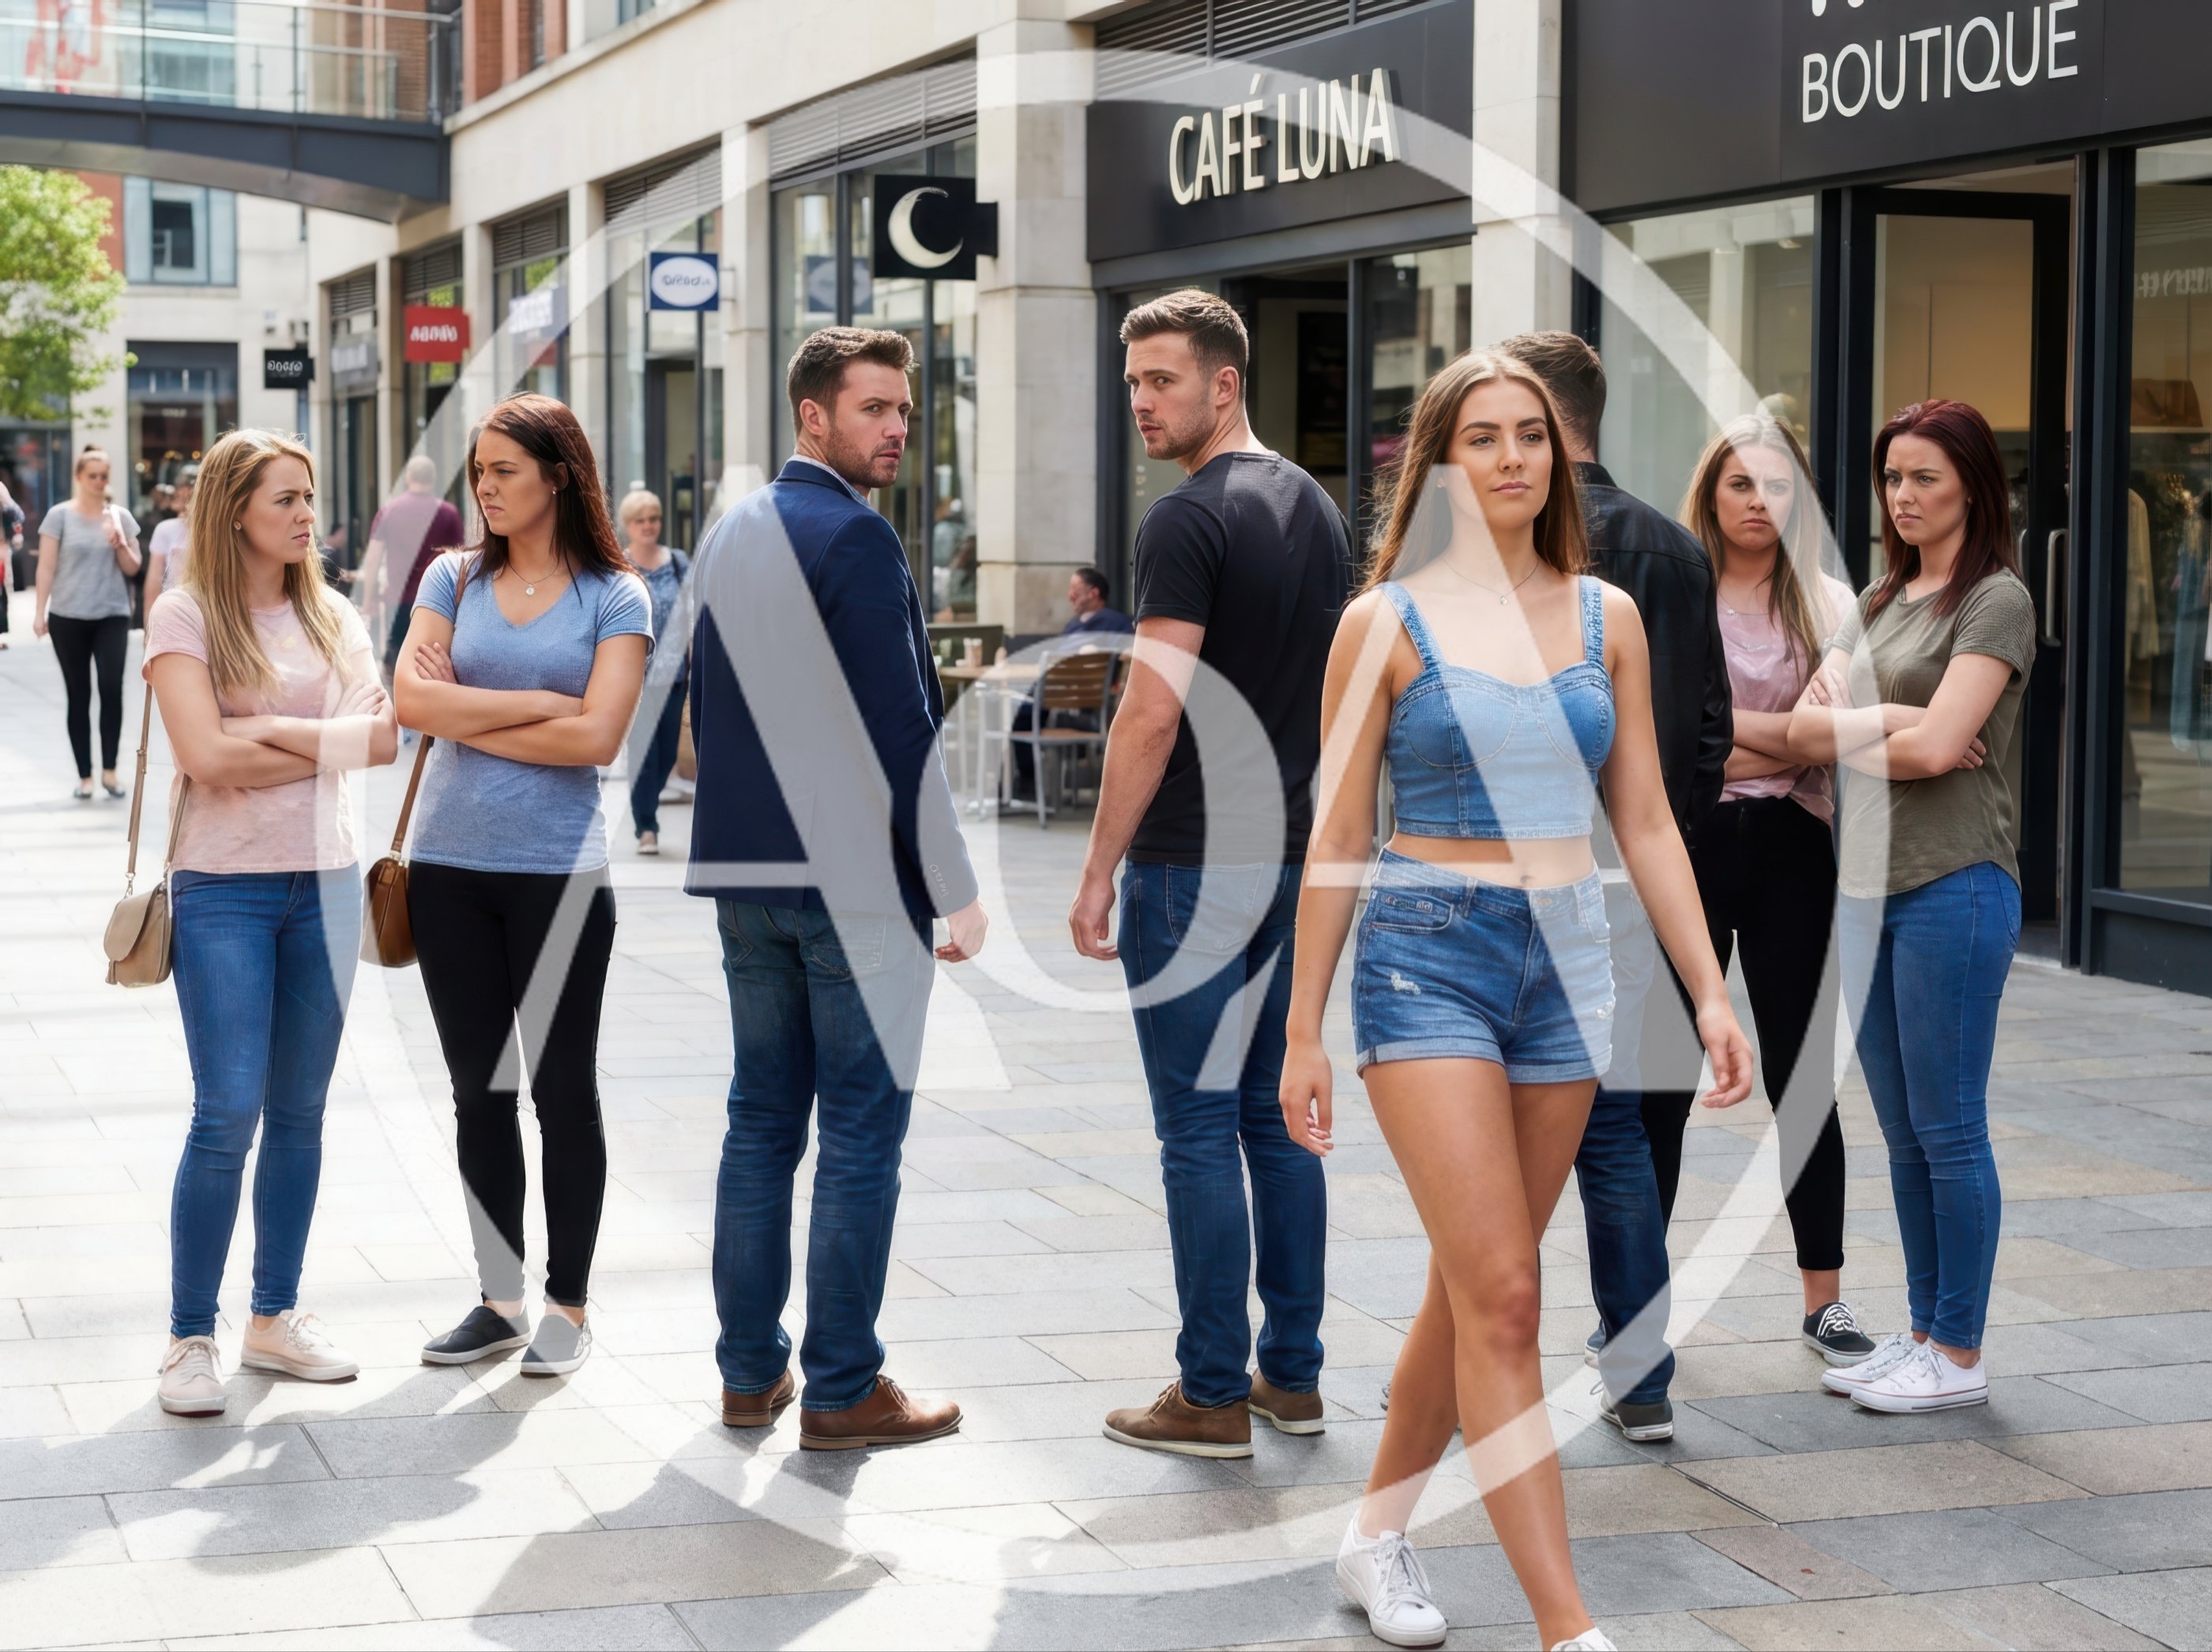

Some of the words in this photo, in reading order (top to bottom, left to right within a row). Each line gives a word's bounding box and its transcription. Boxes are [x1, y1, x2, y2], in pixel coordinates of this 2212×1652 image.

[1803, 0, 2078, 123] BOUTIQUE
[1169, 73, 1266, 205] CAFÉ
[1277, 67, 1397, 183] LUNA
